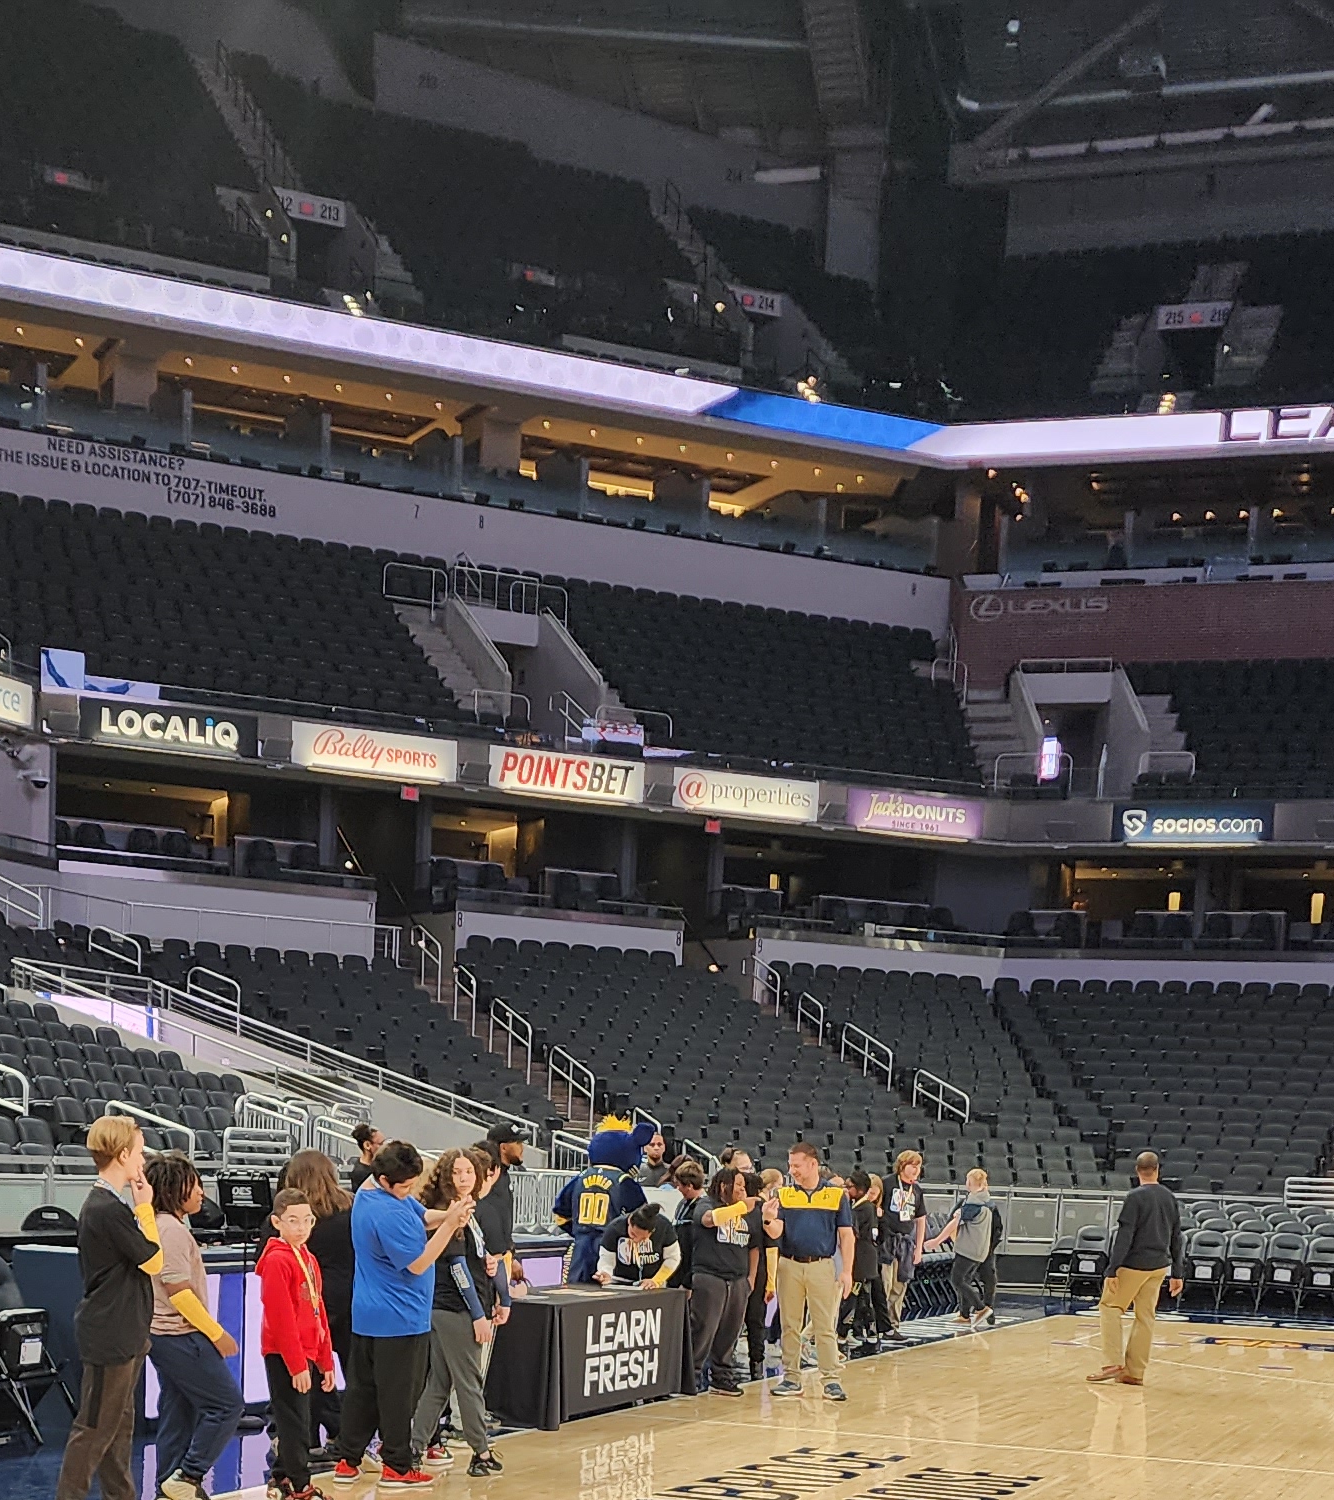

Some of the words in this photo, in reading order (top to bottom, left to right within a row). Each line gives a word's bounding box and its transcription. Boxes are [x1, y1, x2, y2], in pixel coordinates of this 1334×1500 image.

[320, 204, 339, 221] 213
[758, 295, 775, 311] 214
[1165, 310, 1184, 325] 215
[46, 437, 85, 455] NEED
[87, 442, 186, 471] ASSISTANCE?
[25, 451, 68, 470] ISSUE
[71, 456, 82, 472] &
[84, 458, 151, 485] LOCATION
[153, 468, 171, 487] TO
[172, 475, 267, 502] 707-TIMEOUT.
[207, 492, 277, 518] 846-3688
[1007, 596, 1109, 614] LEXUS
[100, 706, 240, 751] LOCALiQ
[312, 728, 387, 769] Bally
[385, 748, 438, 769] SPORTS
[499, 751, 635, 797] POINTSBET
[902, 803, 967, 824] DONUTS
[1152, 814, 1264, 835] socios.com
[891, 820, 917, 832] SINCE
[457, 911, 463, 928] 8
[675, 931, 682, 946] 8
[578, 1192, 610, 1226] 00
[586, 1308, 662, 1355] LEARN
[584, 1348, 659, 1397] FRESH
